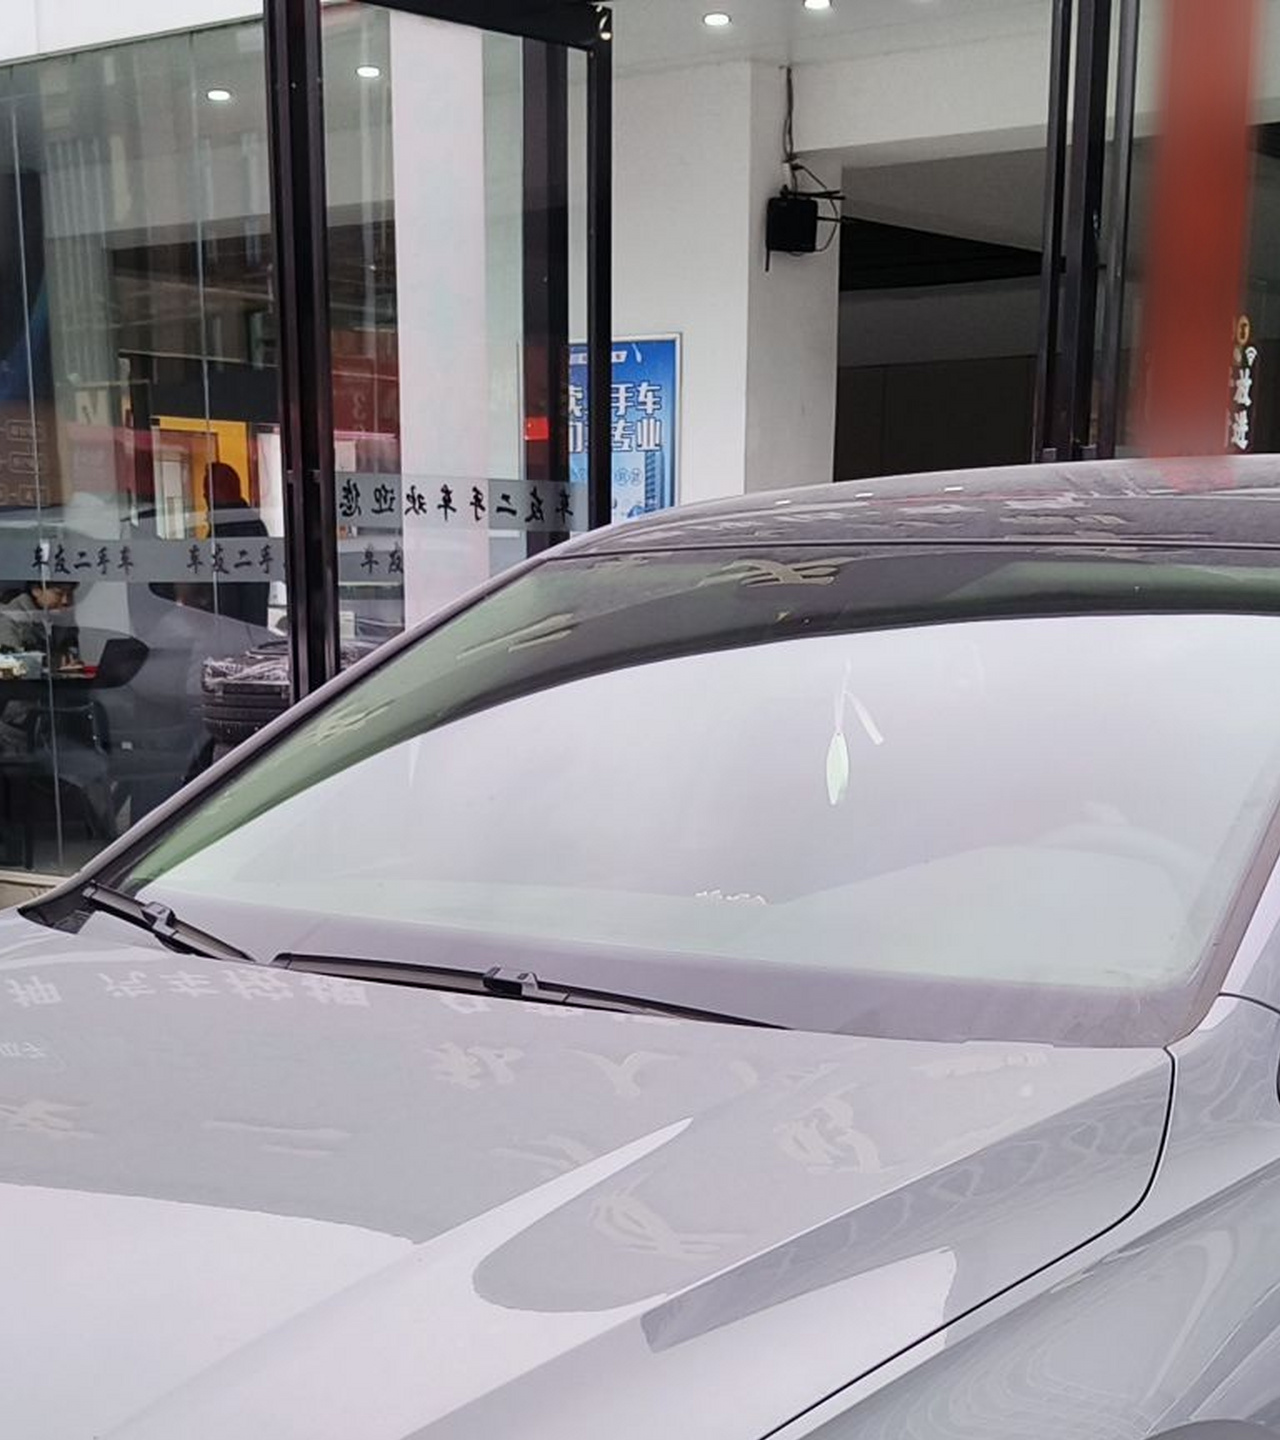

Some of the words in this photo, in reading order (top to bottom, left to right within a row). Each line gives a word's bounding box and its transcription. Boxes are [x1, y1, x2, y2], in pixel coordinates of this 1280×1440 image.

[31, 547, 134, 575] 车友二手车
[187, 545, 275, 575] 车友二手
